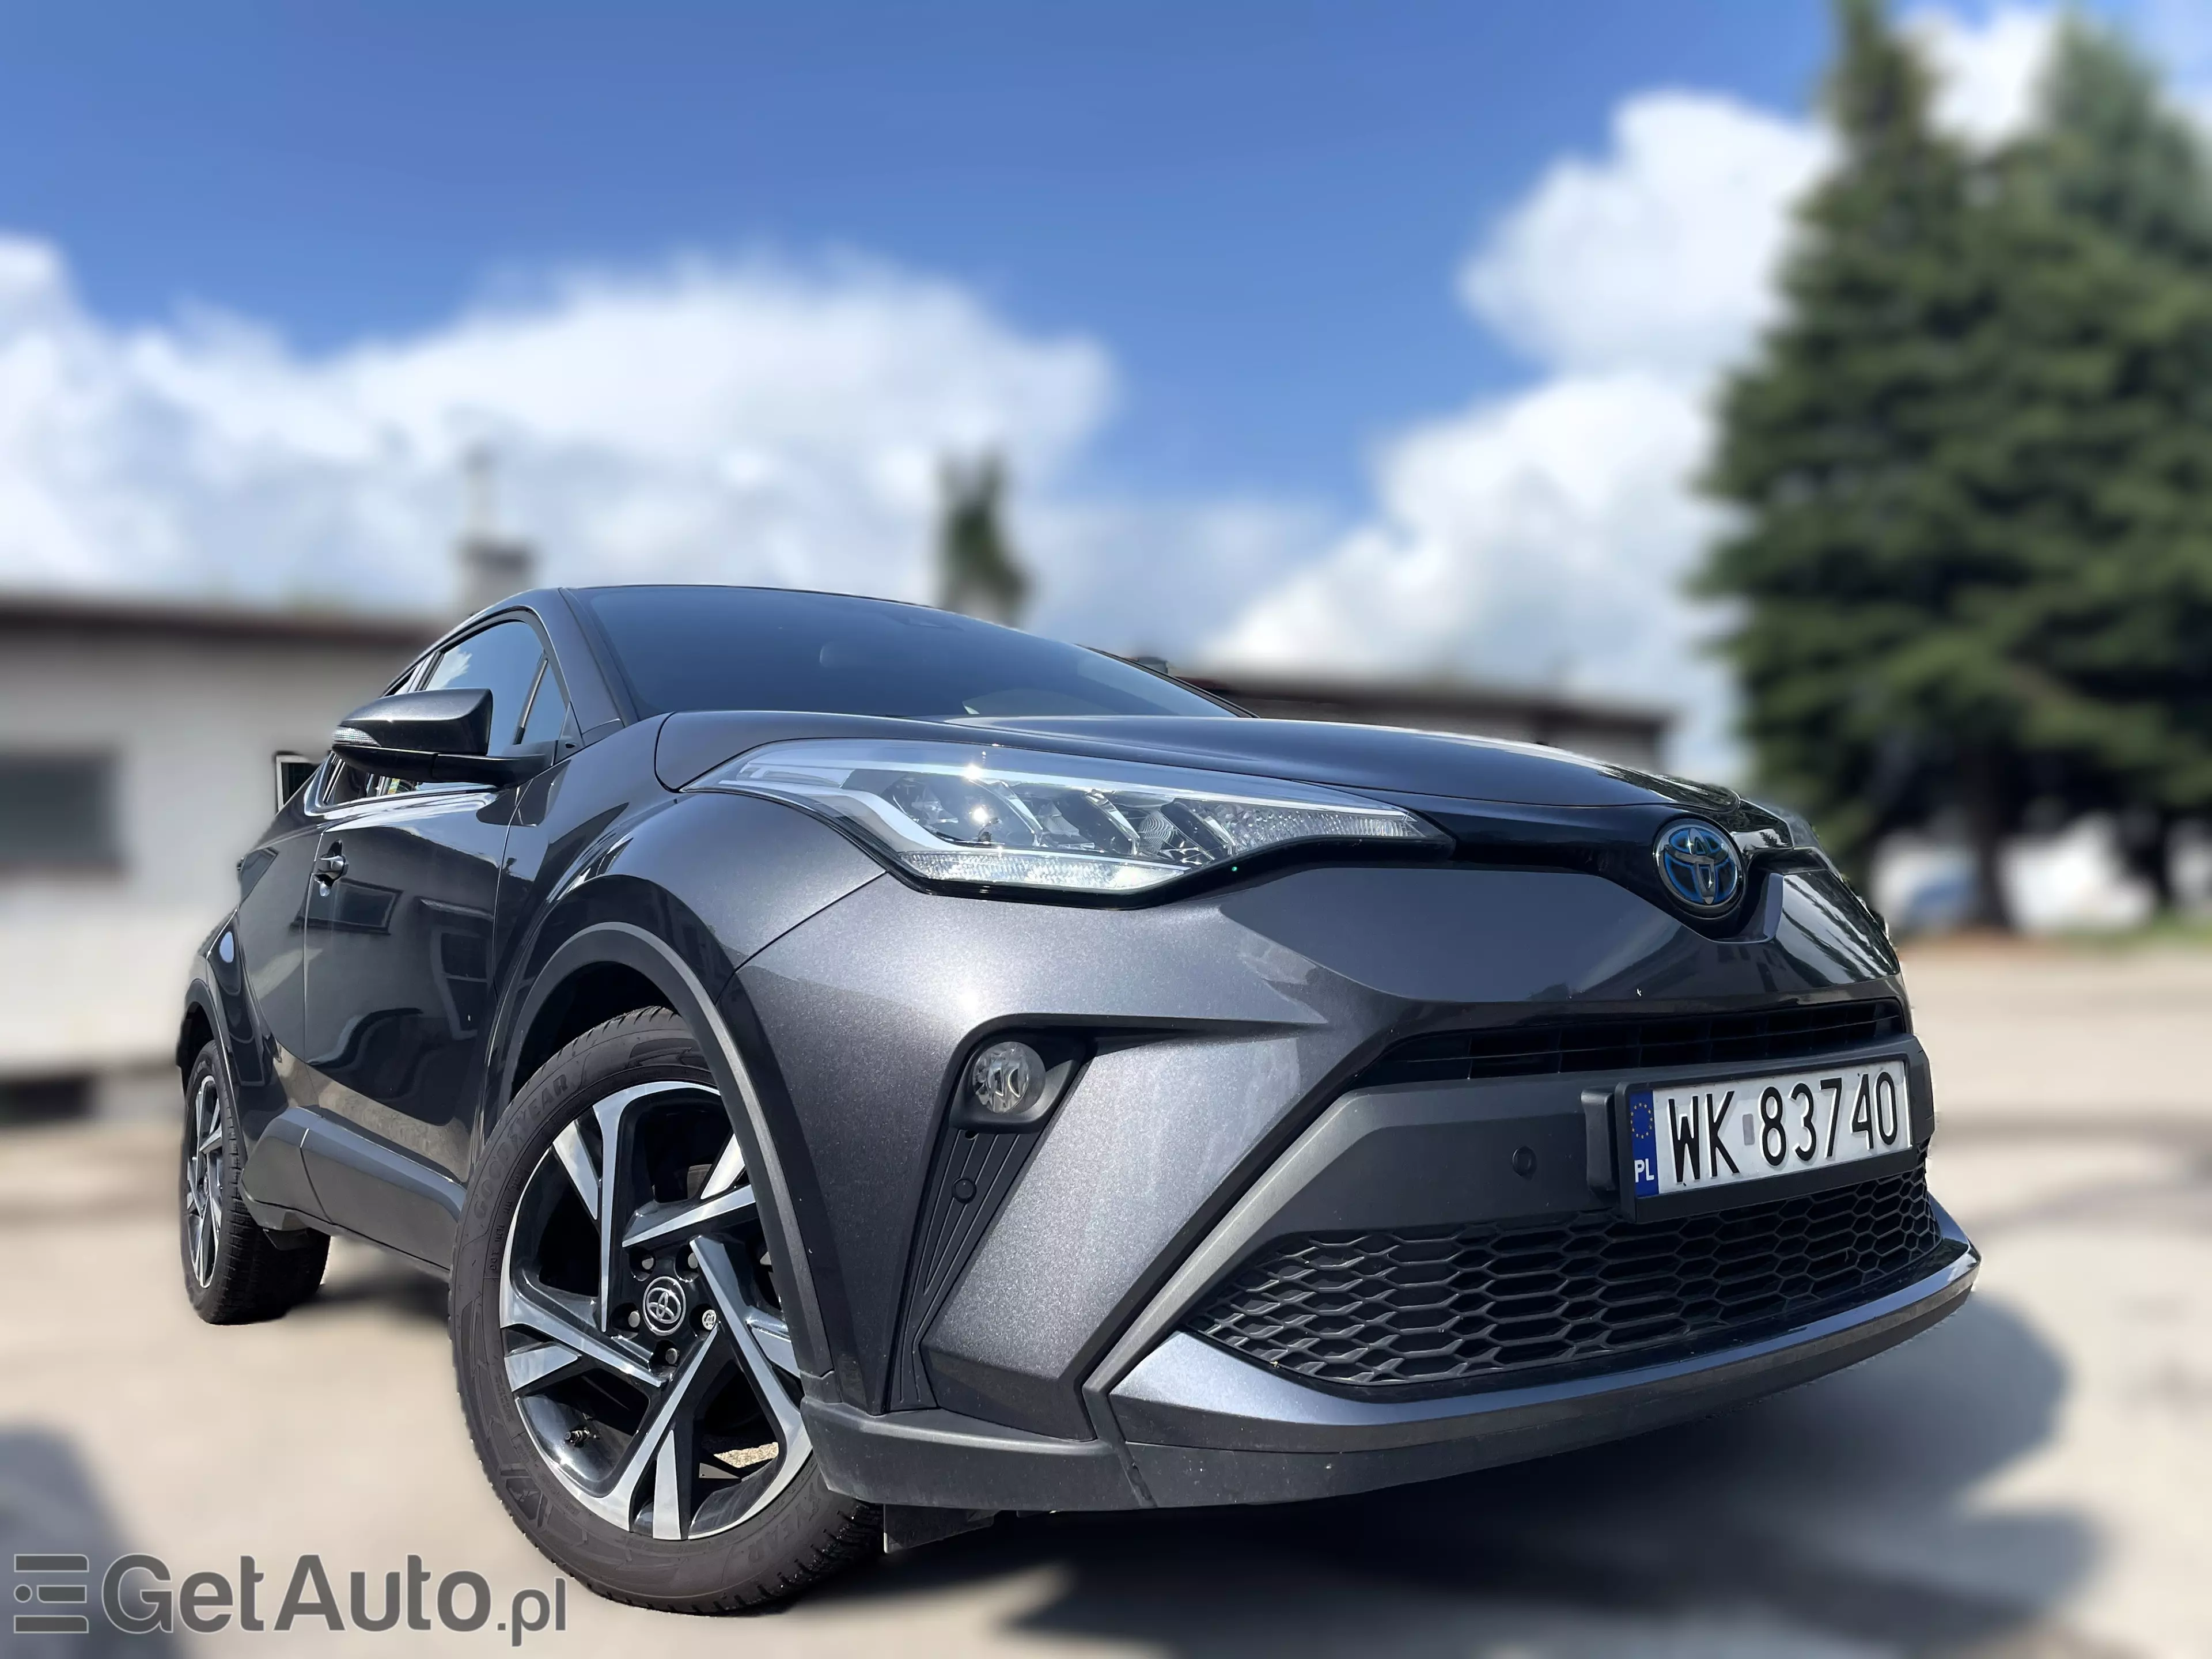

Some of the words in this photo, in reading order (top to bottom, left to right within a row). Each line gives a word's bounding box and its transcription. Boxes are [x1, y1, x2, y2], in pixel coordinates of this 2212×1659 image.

[474, 1074, 569, 1219] GOODYEAR
[1634, 1158, 1654, 1183] PL
[1668, 1090, 1740, 1184] WK
[1759, 1071, 1897, 1166] 83740
